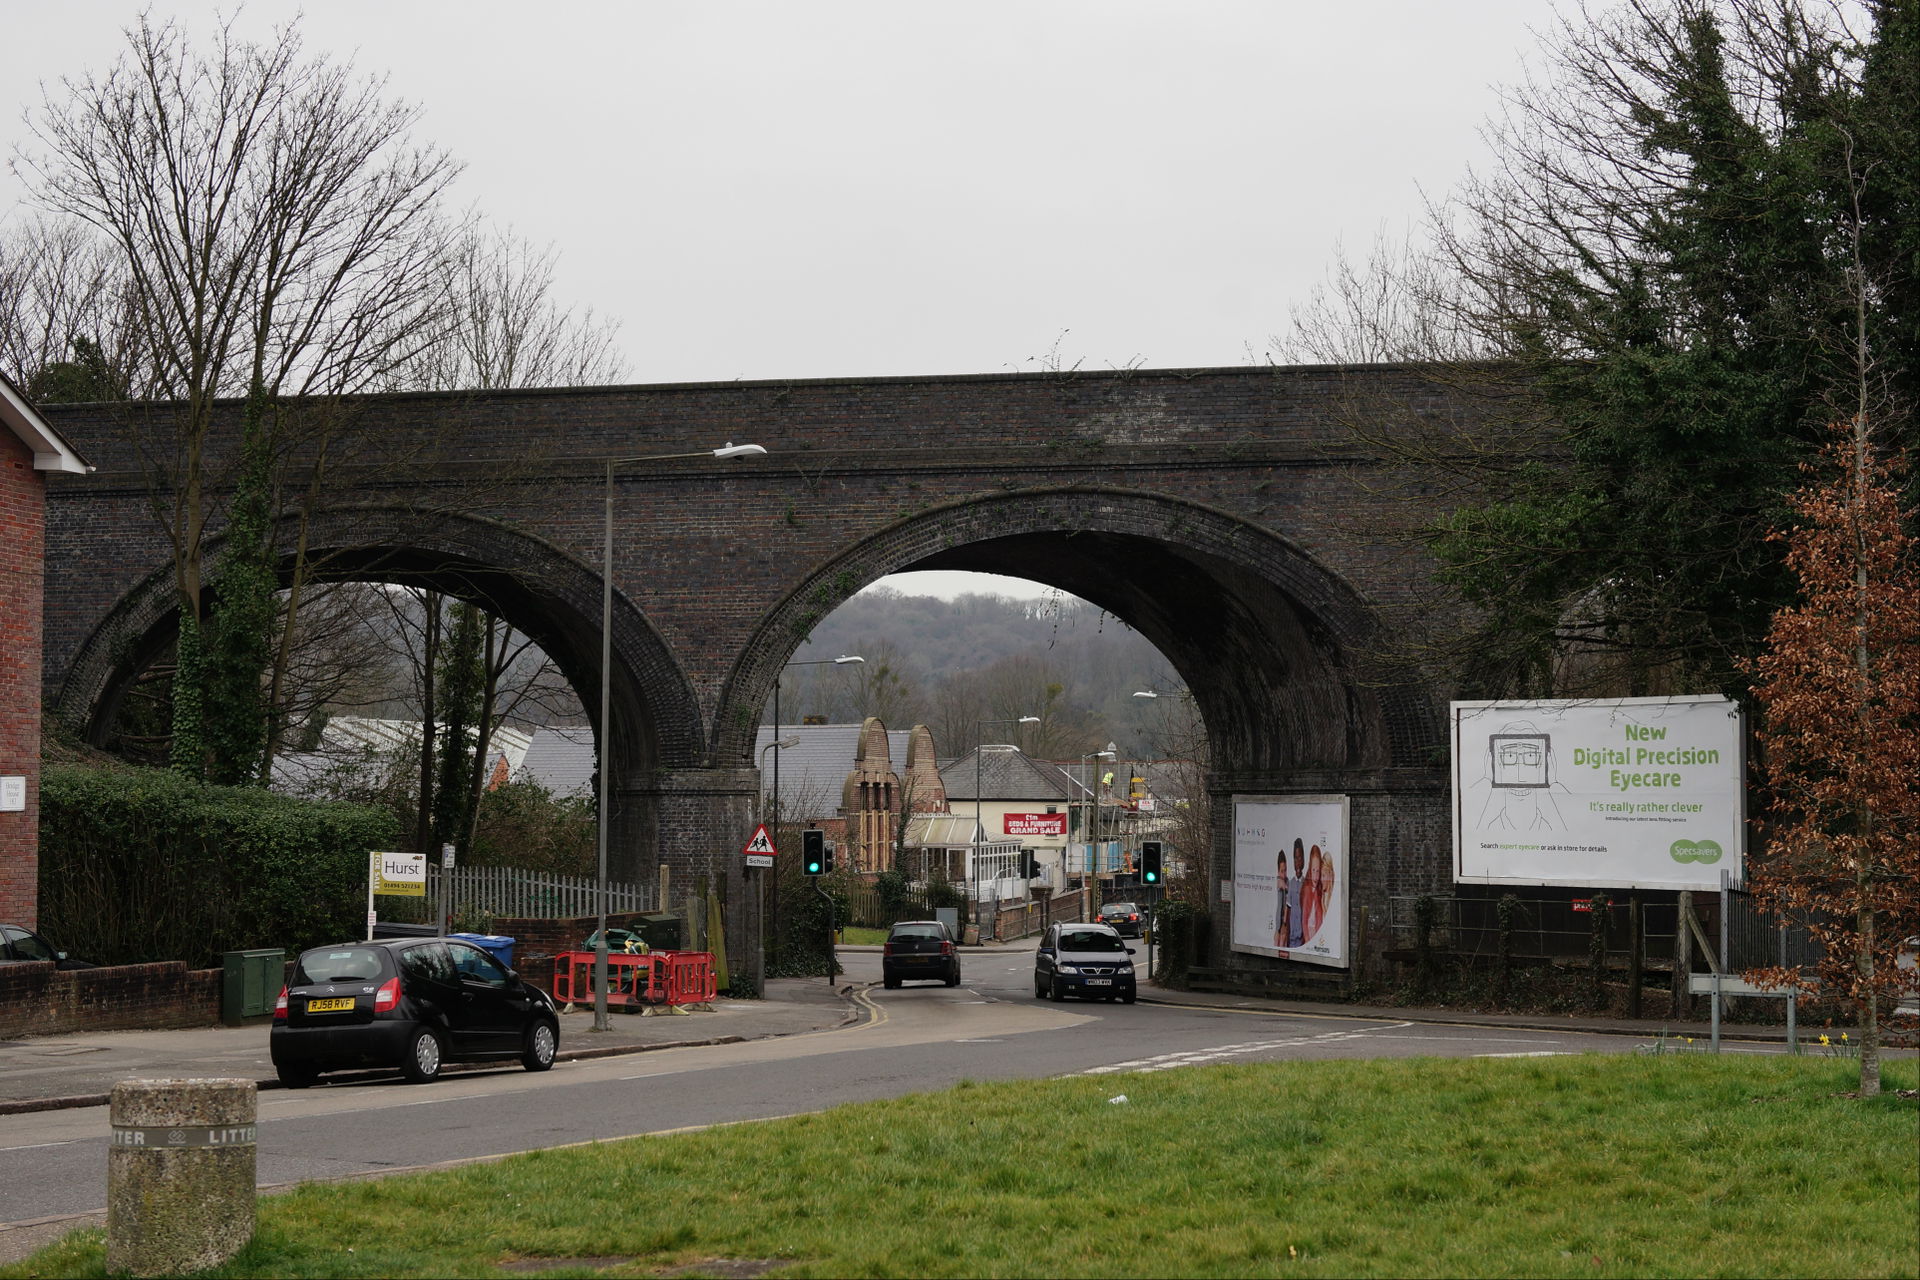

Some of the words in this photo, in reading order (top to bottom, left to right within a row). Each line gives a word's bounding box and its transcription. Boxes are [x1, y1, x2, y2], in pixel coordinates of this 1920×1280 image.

[1625, 724, 1667, 741] New
[1574, 747, 1631, 769] Digital
[1636, 747, 1719, 765] Precision
[1610, 770, 1681, 791] Eyecare
[1590, 802, 1604, 812] It's
[1606, 802, 1635, 814] really
[1637, 802, 1669, 812] rather
[1671, 802, 1703, 813] clever
[1674, 846, 1717, 857] Specsavers
[384, 861, 420, 874] Hurst
[311, 1000, 333, 1010] RJ58
[334, 1000, 351, 1008] RVF
